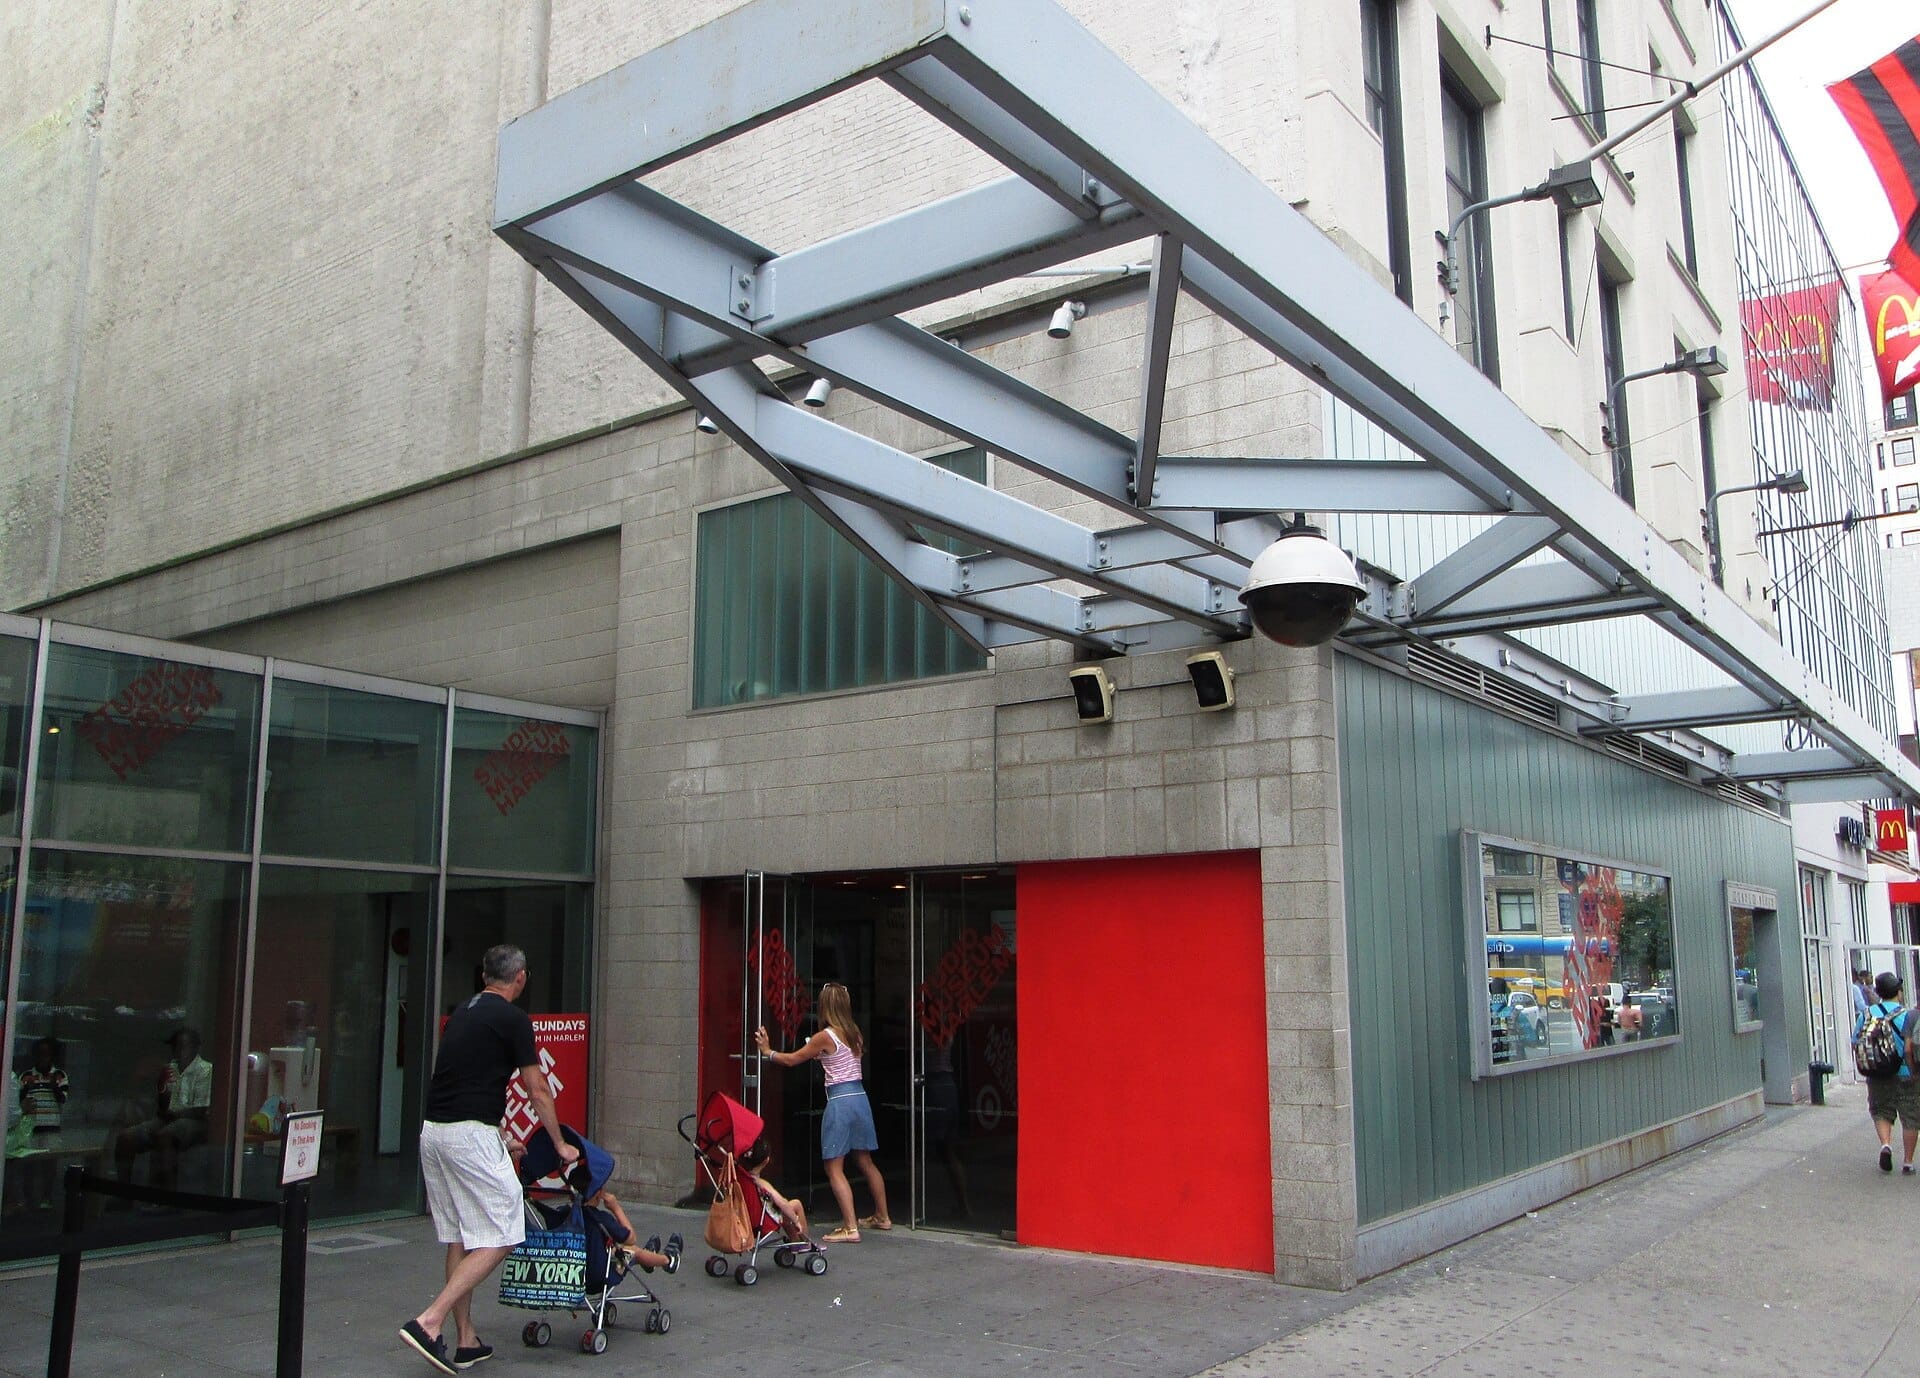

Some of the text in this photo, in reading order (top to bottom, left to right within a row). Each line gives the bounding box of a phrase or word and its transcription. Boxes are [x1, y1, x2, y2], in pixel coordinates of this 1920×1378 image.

[532, 1020, 586, 1032] SUNDAYS
[553, 1034, 585, 1042] HARLEM
[540, 1249, 555, 1257] YORK
[503, 1261, 583, 1285] EW YORK
